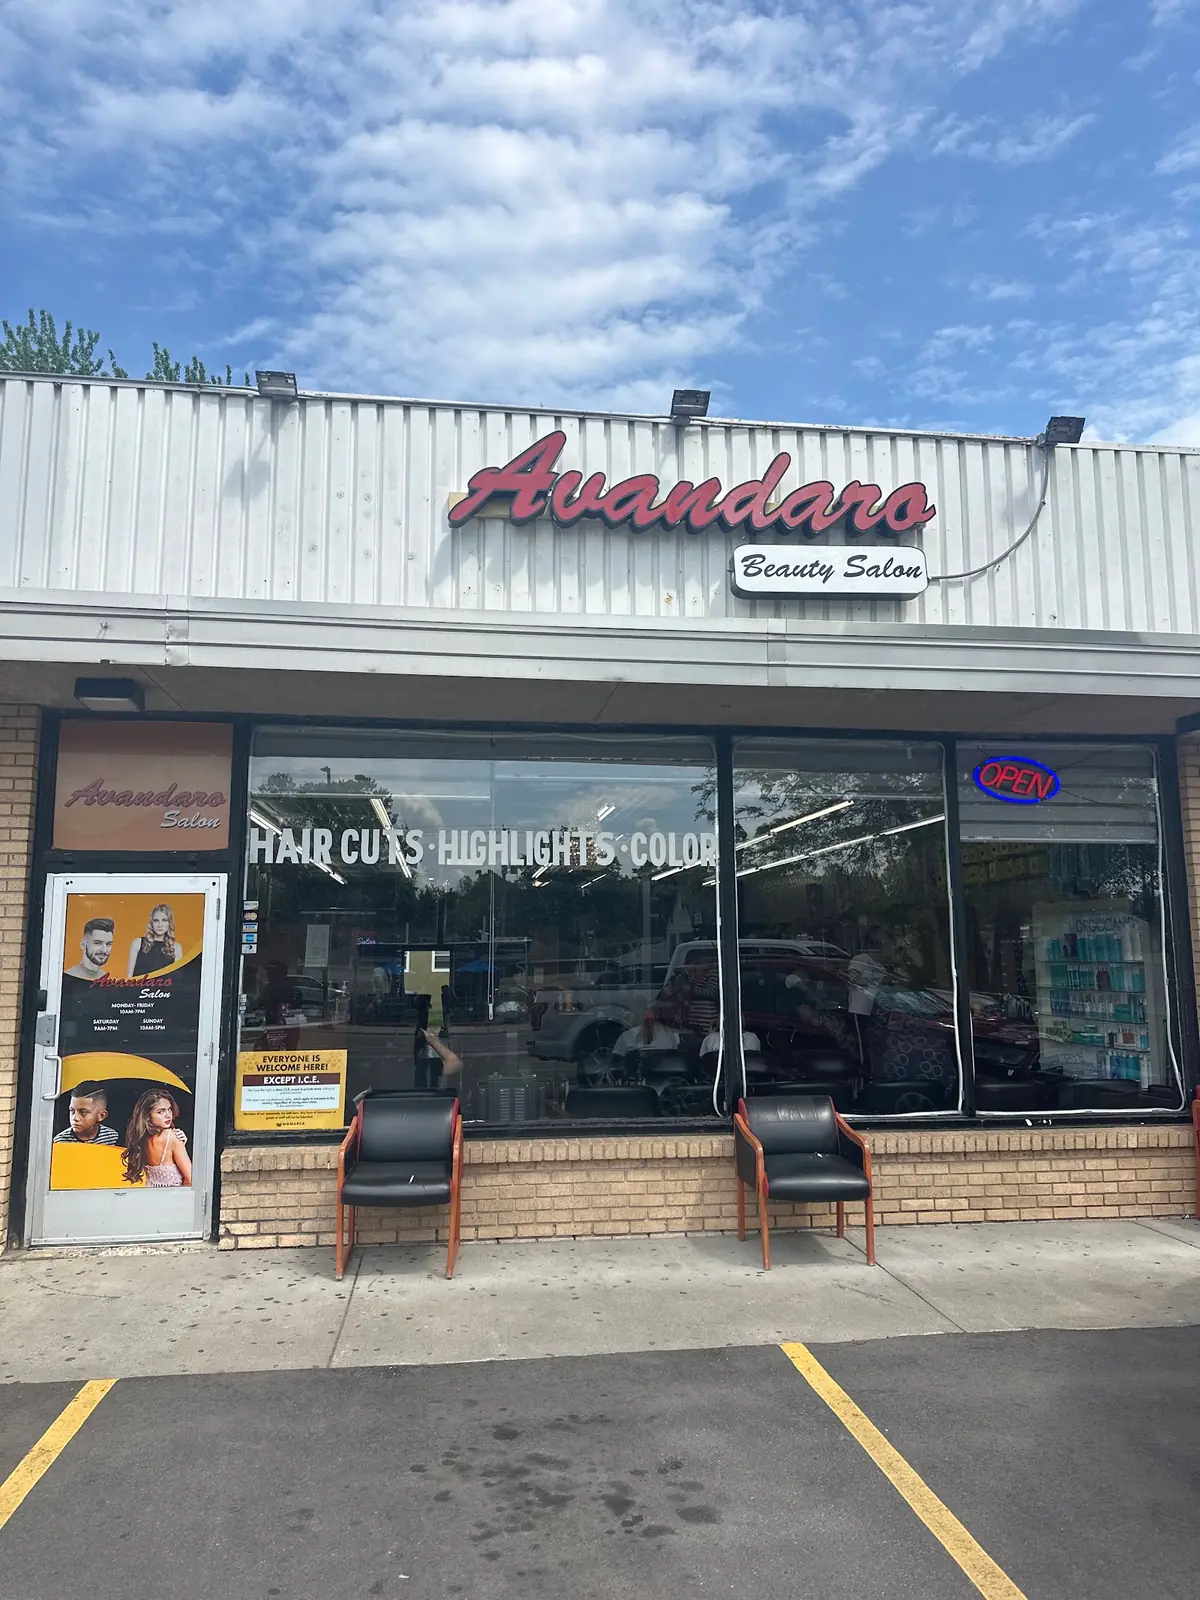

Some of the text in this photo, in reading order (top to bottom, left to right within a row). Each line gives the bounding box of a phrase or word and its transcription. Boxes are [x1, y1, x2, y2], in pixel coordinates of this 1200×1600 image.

[448, 430, 936, 536] Avandaro
[741, 553, 923, 580] Beauty Salon
[979, 762, 1054, 798] OPEN
[65, 778, 226, 808] Avandaro
[160, 810, 221, 829] Salon
[249, 828, 718, 868] HAIR CUTS HIGHLIGHTS COLOR
[89, 972, 172, 988] Avandaro
[138, 988, 171, 999] Salon
[256, 1063, 328, 1072] WELCOME HERE!
[262, 1055, 310, 1063] EVERYONE
[263, 1076, 320, 1085] EXCEPT I.C.E.
